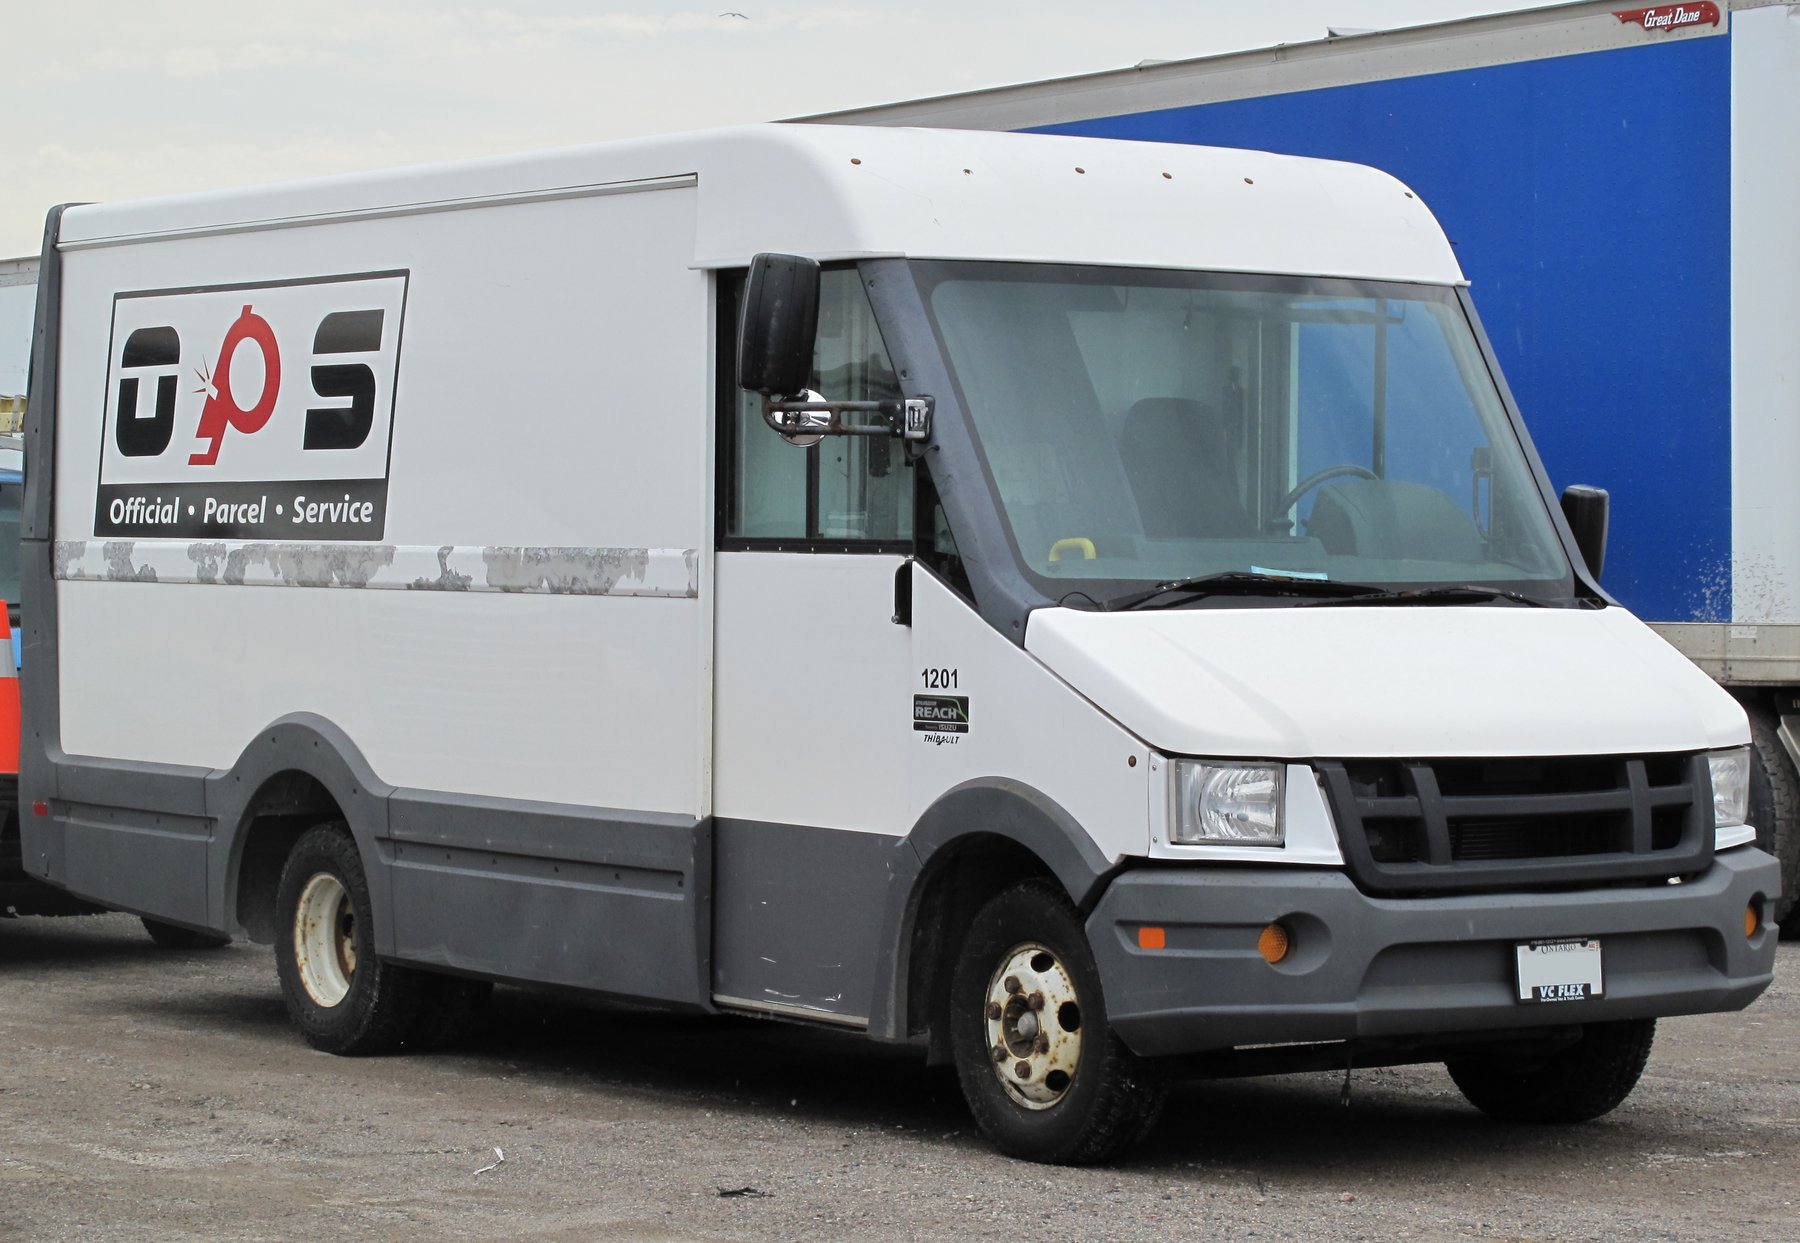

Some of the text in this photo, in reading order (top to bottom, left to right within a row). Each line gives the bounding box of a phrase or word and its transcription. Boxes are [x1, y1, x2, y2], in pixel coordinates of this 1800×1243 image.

[1644, 8, 1700, 27] Great Dane
[109, 494, 374, 524] Official Parcel Service
[921, 668, 958, 689] 1201
[915, 706, 957, 719] REACH
[1540, 984, 1584, 998] VC FLEX
